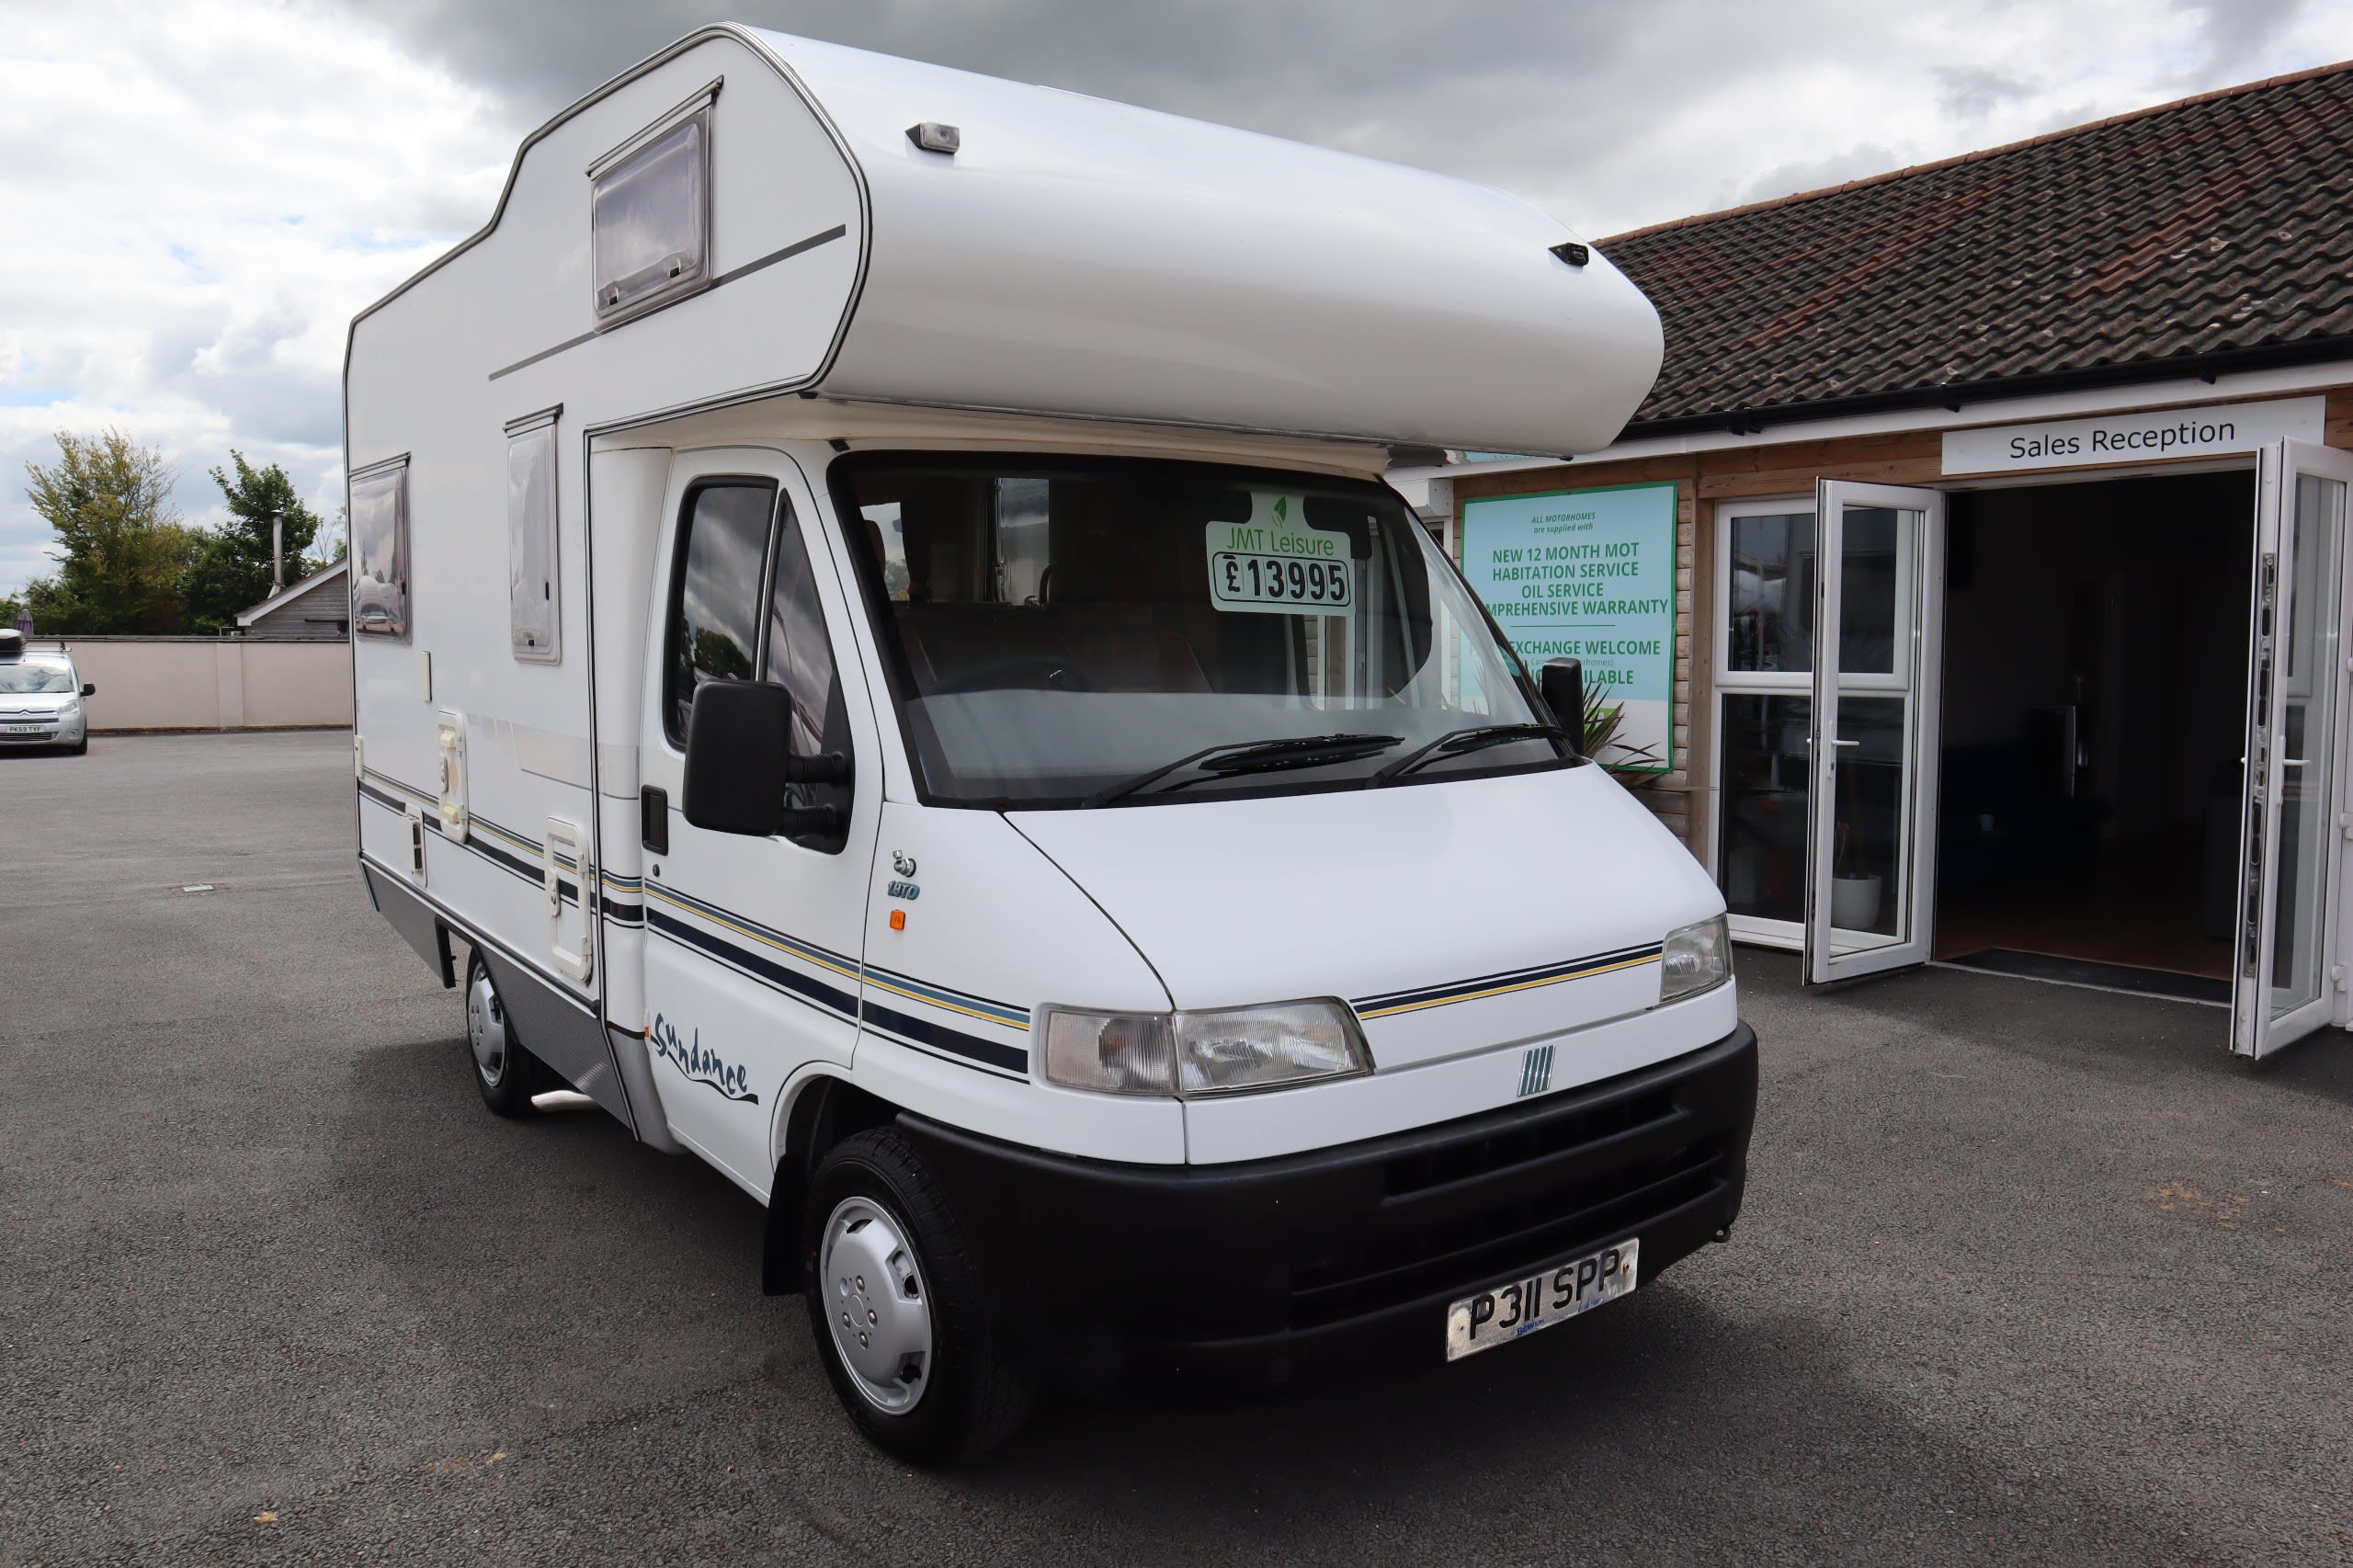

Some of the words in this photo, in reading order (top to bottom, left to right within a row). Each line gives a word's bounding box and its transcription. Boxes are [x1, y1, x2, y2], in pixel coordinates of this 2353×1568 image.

[2009, 434, 2081, 459] Sales
[2092, 420, 2235, 452] Reception
[1531, 515, 1543, 524] ALL
[1545, 511, 1596, 523] MOTORHOMES
[1546, 523, 1576, 535] supplied
[1577, 522, 1594, 530] with
[1227, 527, 1265, 551] JMT
[1270, 529, 1335, 555] Leisure
[1492, 549, 1524, 563] NEW
[1527, 547, 1542, 562] 12
[1545, 544, 1600, 561] MONTH
[1605, 541, 1640, 557] MOT
[1222, 554, 1346, 601] £13995
[1492, 564, 1575, 582] HABITATION
[1580, 562, 1640, 578] SERVICE
[1521, 585, 1544, 599] OIL
[1547, 582, 1604, 598] SERVICE
[1485, 600, 1579, 617] MPREHENSIVE
[1582, 598, 1668, 615] WARRANTY
[1586, 640, 1661, 655] WELCOME
[1584, 669, 1634, 685] ILABLE
[654, 1012, 748, 1095] Sundance
[1469, 1277, 1542, 1340] P311
[1552, 1248, 1620, 1310] SPP
